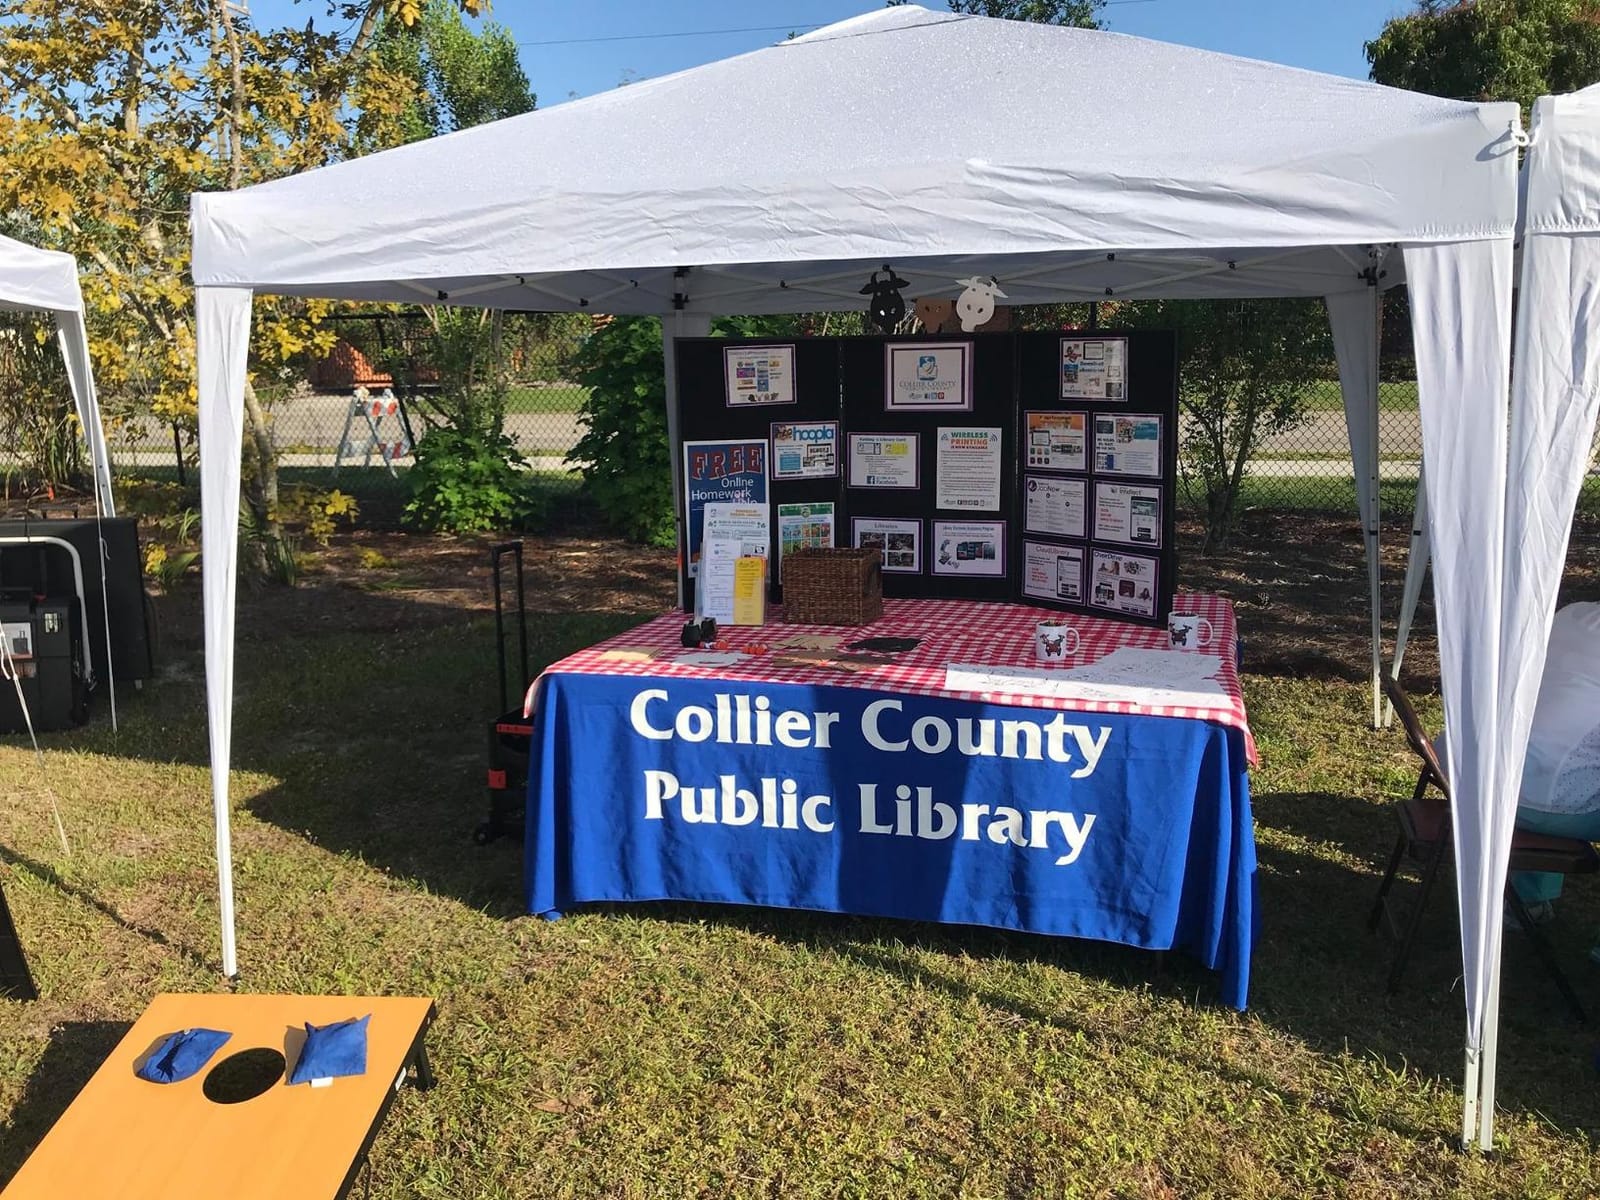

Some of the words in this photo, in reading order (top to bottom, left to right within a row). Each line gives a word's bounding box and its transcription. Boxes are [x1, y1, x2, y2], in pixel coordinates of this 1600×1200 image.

[793, 425, 834, 443] hoopla
[691, 447, 763, 480] FREE
[691, 487, 752, 501] Homework
[721, 477, 755, 488] Online
[630, 689, 839, 749] Collier
[861, 698, 1113, 780] County
[643, 769, 836, 833] Public
[859, 783, 1098, 866] Library
